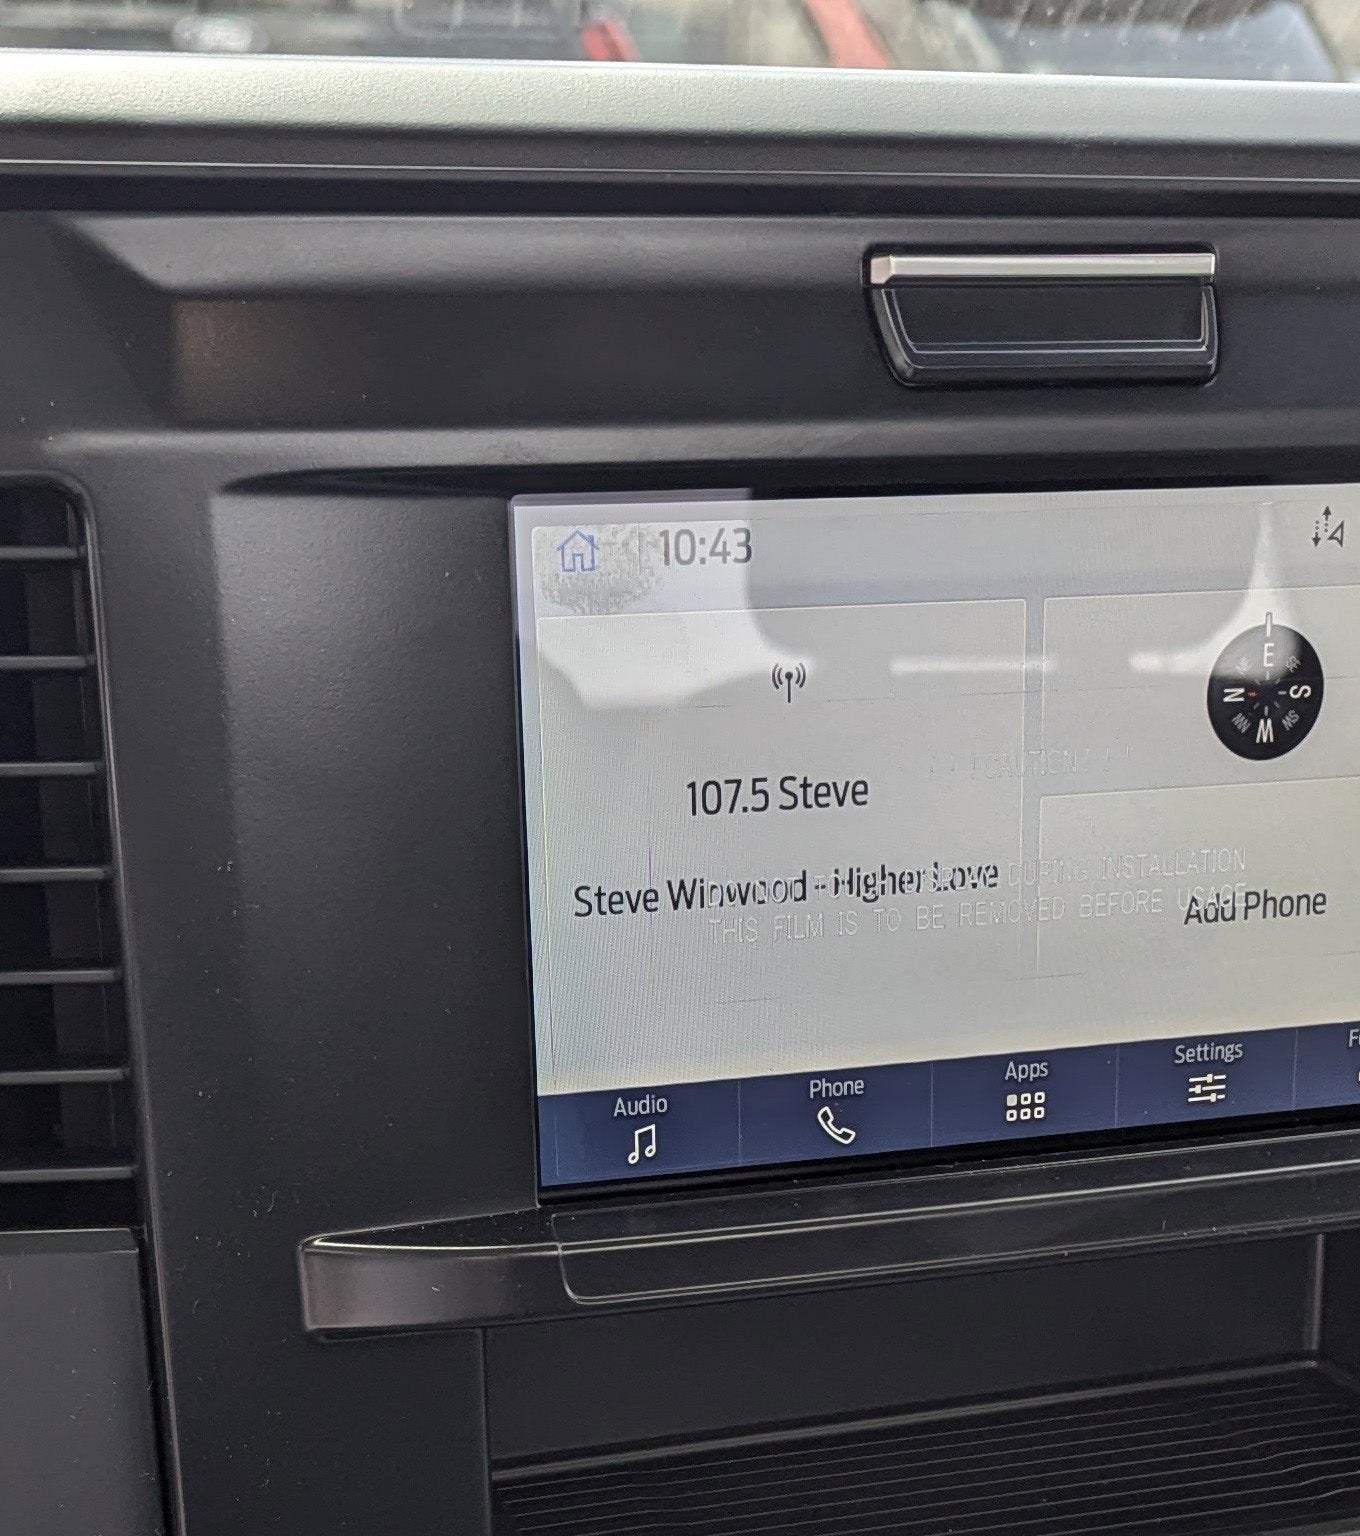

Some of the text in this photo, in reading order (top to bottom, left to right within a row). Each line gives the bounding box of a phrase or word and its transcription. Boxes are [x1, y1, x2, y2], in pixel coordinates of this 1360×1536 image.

[658, 526, 753, 567] 10:43
[1222, 688, 1246, 703] N
[1288, 685, 1312, 700] S
[1255, 717, 1275, 744] W
[686, 774, 870, 817] 107.5 Steve
[1101, 848, 1247, 880] INSTALLATION
[573, 884, 660, 918] Steve
[1183, 888, 1328, 926] Add Phone
[708, 916, 759, 944] THIS
[838, 910, 860, 937] IS
[872, 907, 902, 934] TO
[915, 903, 945, 931] BE
[959, 895, 1066, 928] REMOVED
[1080, 889, 1163, 919] BEFORE
[1173, 1040, 1244, 1066] Settings
[1004, 1059, 1050, 1083] Apps
[809, 1076, 866, 1100] Phone
[613, 1095, 669, 1119] Audio
